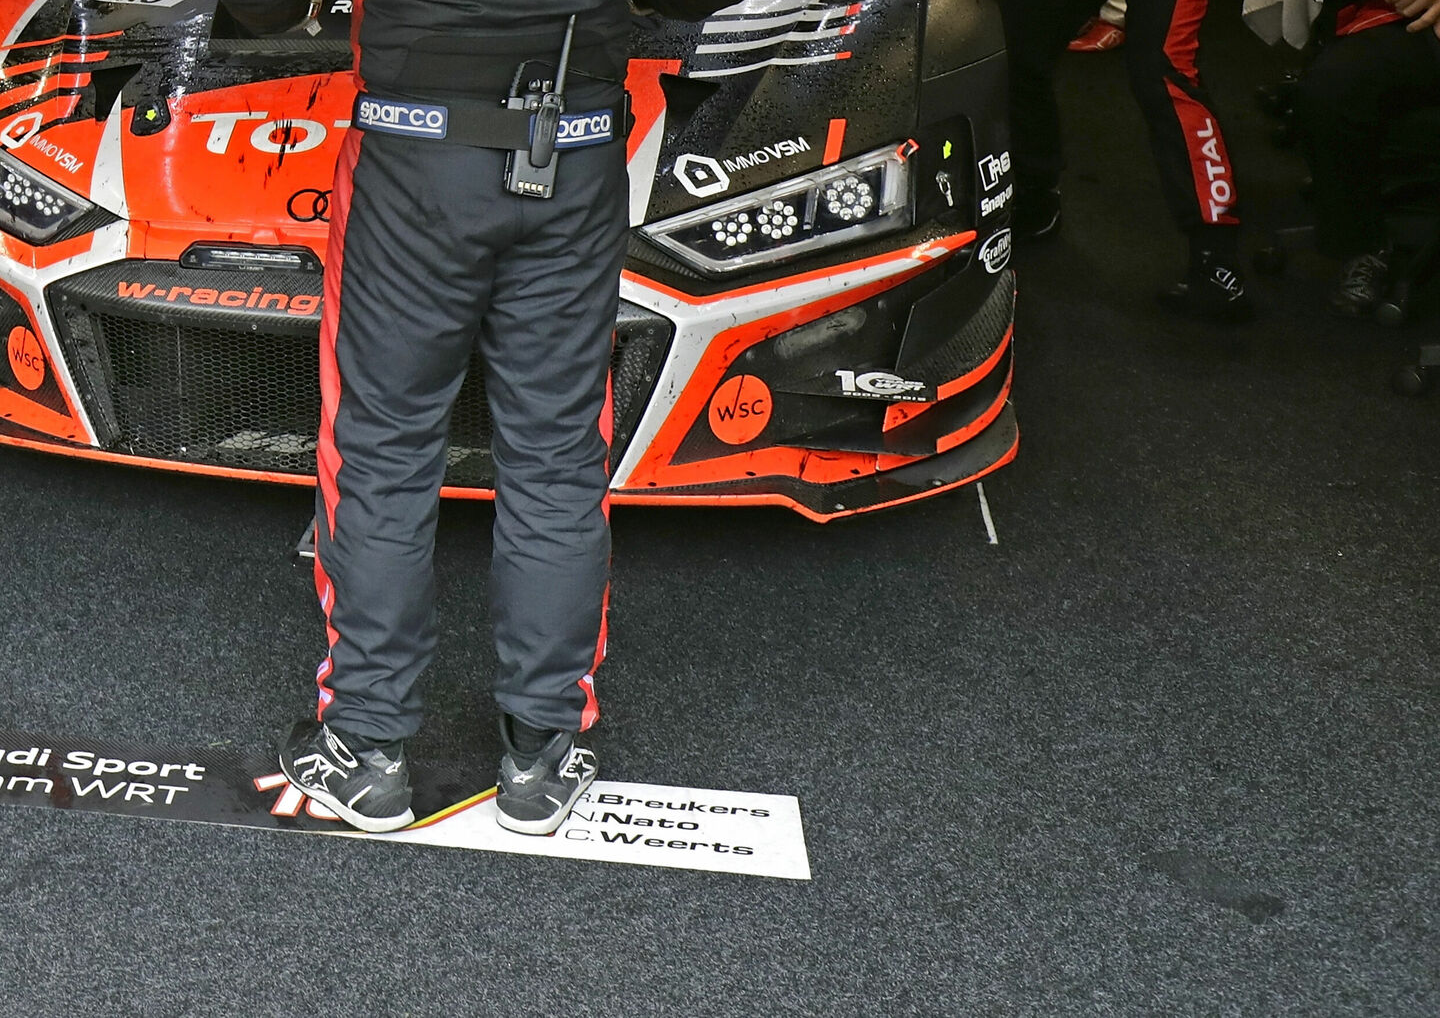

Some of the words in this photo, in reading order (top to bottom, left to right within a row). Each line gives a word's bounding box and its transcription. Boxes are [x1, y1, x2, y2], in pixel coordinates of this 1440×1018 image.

[360, 99, 444, 131] sparco
[1196, 117, 1231, 223] TOTAL
[117, 281, 325, 317] w-racing
[11, 345, 42, 373] WSC
[716, 398, 765, 423] WSC
[62, 752, 207, 782] Sport
[70, 776, 190, 806] WRT
[564, 827, 756, 857] C.Weerts
